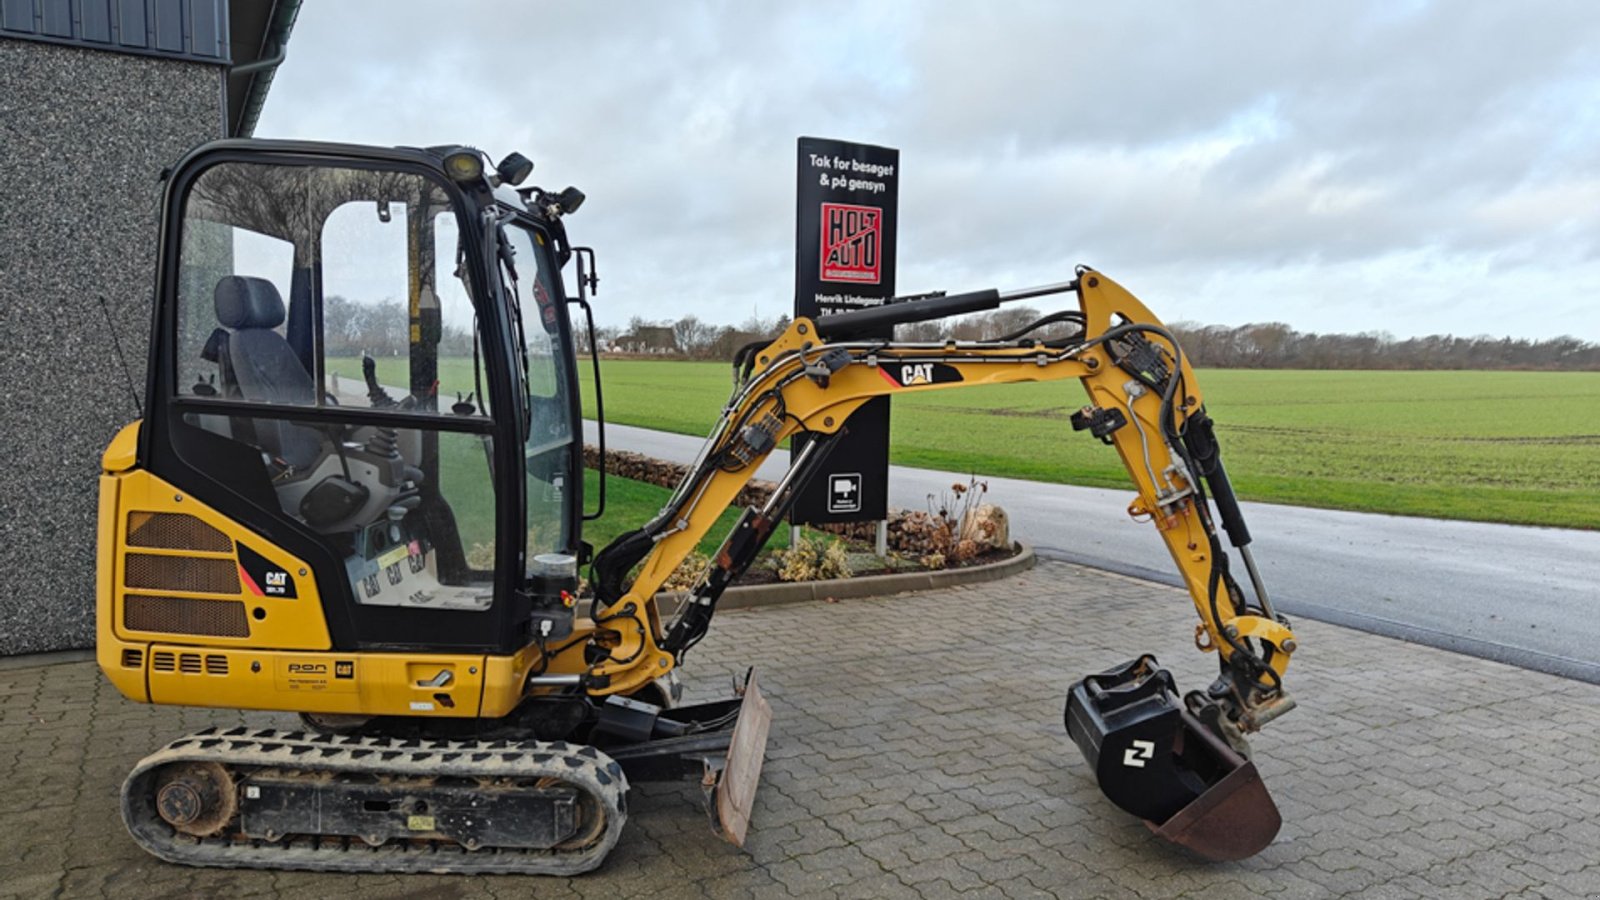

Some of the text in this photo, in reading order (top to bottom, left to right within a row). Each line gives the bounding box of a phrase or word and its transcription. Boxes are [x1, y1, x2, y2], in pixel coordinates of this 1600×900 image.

[809, 154, 893, 177] Tak for besøget
[819, 174, 886, 194] & på gensyn
[829, 208, 876, 246] HOLT
[827, 230, 876, 267] AUTO
[815, 293, 843, 304] Henrik
[901, 363, 934, 386] CAT
[266, 572, 287, 585] CAT
[337, 664, 352, 675] CAT
